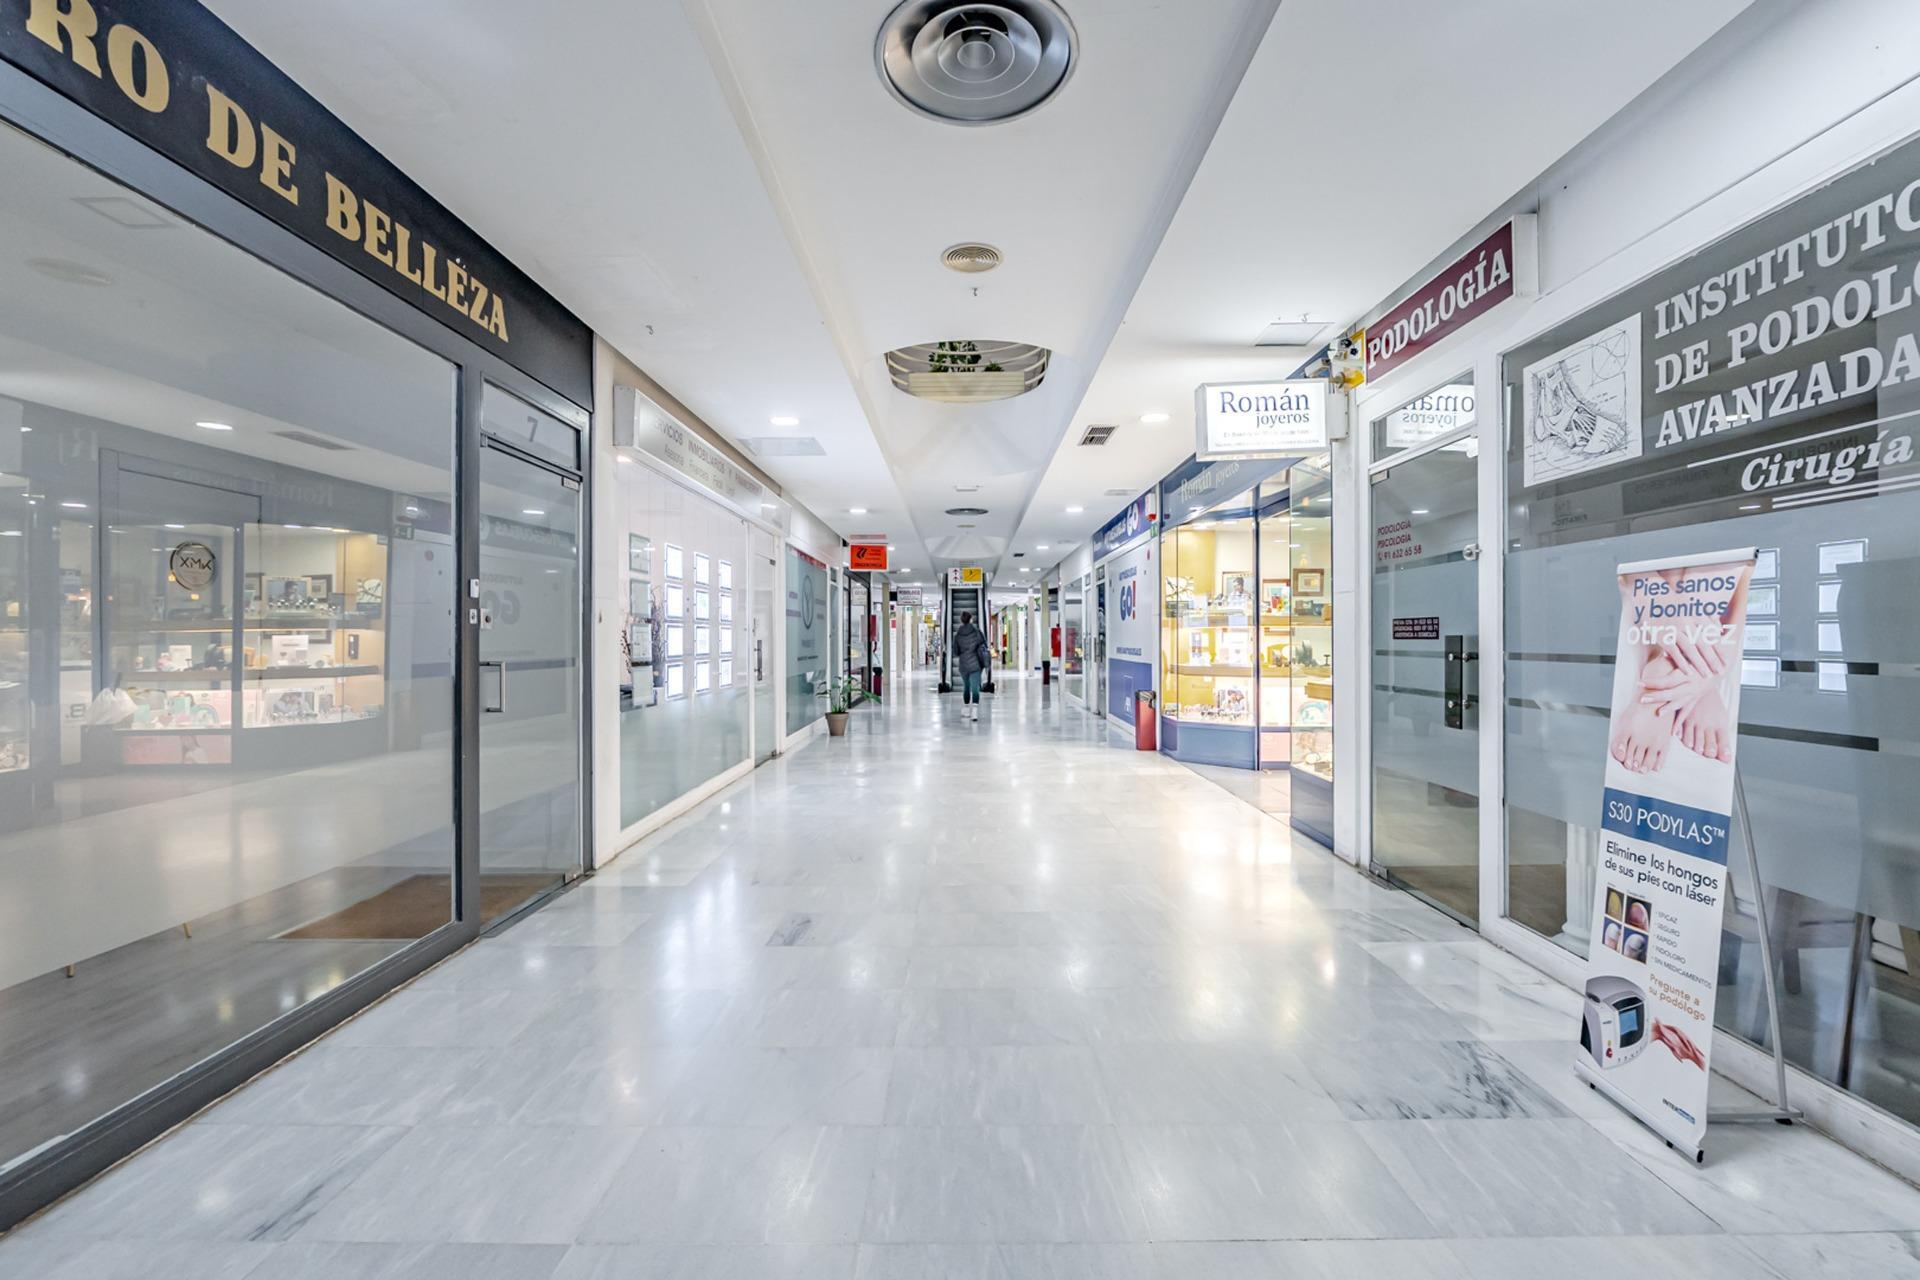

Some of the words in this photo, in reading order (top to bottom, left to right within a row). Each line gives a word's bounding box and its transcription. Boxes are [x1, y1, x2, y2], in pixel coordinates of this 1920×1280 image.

[26, 0, 170, 113] RO
[206, 83, 298, 206] DE
[1368, 248, 1511, 369] PODOLOGÍA
[1655, 340, 1709, 394] DE
[1728, 258, 1920, 369] PODOL
[1219, 388, 1310, 413] Román
[1655, 333, 1920, 448] AVANZADA
[527, 416, 538, 442] 7
[1256, 412, 1309, 428] joyeros
[1741, 430, 1914, 492] Cirugía
[1633, 578, 1670, 597] Pies
[1675, 576, 1736, 594] sanos
[1634, 605, 1645, 624] y
[1650, 597, 1729, 618] bonitos
[1627, 621, 1677, 645] otra
[1684, 624, 1737, 645] vez
[1608, 801, 1632, 823] S30
[1606, 841, 1647, 865] Elimine
[1651, 854, 1665, 872] los
[1667, 860, 1718, 889] hongos
[1605, 858, 1617, 871] de
[1619, 865, 1634, 878] sus
[1637, 871, 1660, 887] pies
[1662, 881, 1682, 895] con
[1686, 885, 1716, 906] láser
[1649, 974, 1691, 1001] Pregunte
[1694, 997, 1701, 1006] a
[1663, 962, 1712, 990] MEDICAMENTOS
[1649, 986, 1657, 996] su
